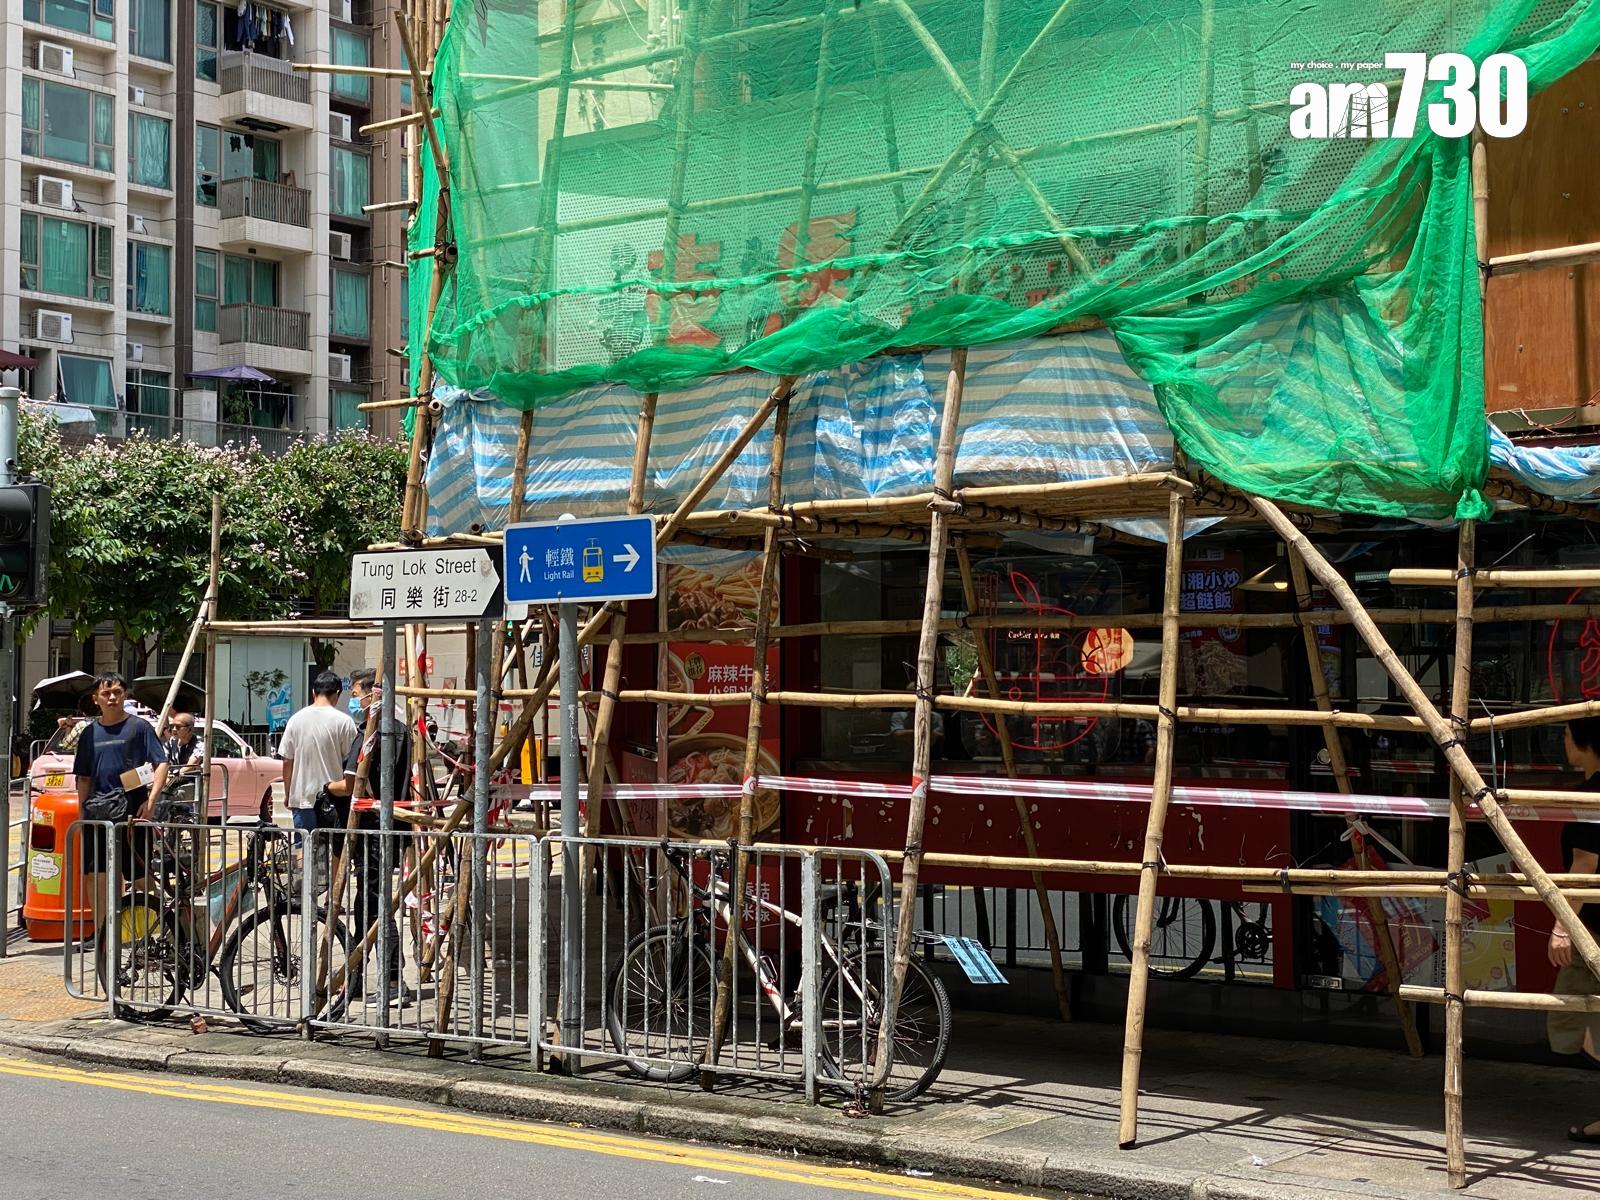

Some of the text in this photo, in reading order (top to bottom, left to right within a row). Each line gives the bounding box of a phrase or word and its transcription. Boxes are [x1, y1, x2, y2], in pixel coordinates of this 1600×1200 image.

[545, 547, 574, 567] 輕鐵
[361, 557, 476, 580] Tung Lok Street
[543, 570, 574, 583] Light Rail
[1181, 570, 1241, 591] 湘小炒
[381, 586, 477, 610] 同樂街 28-2
